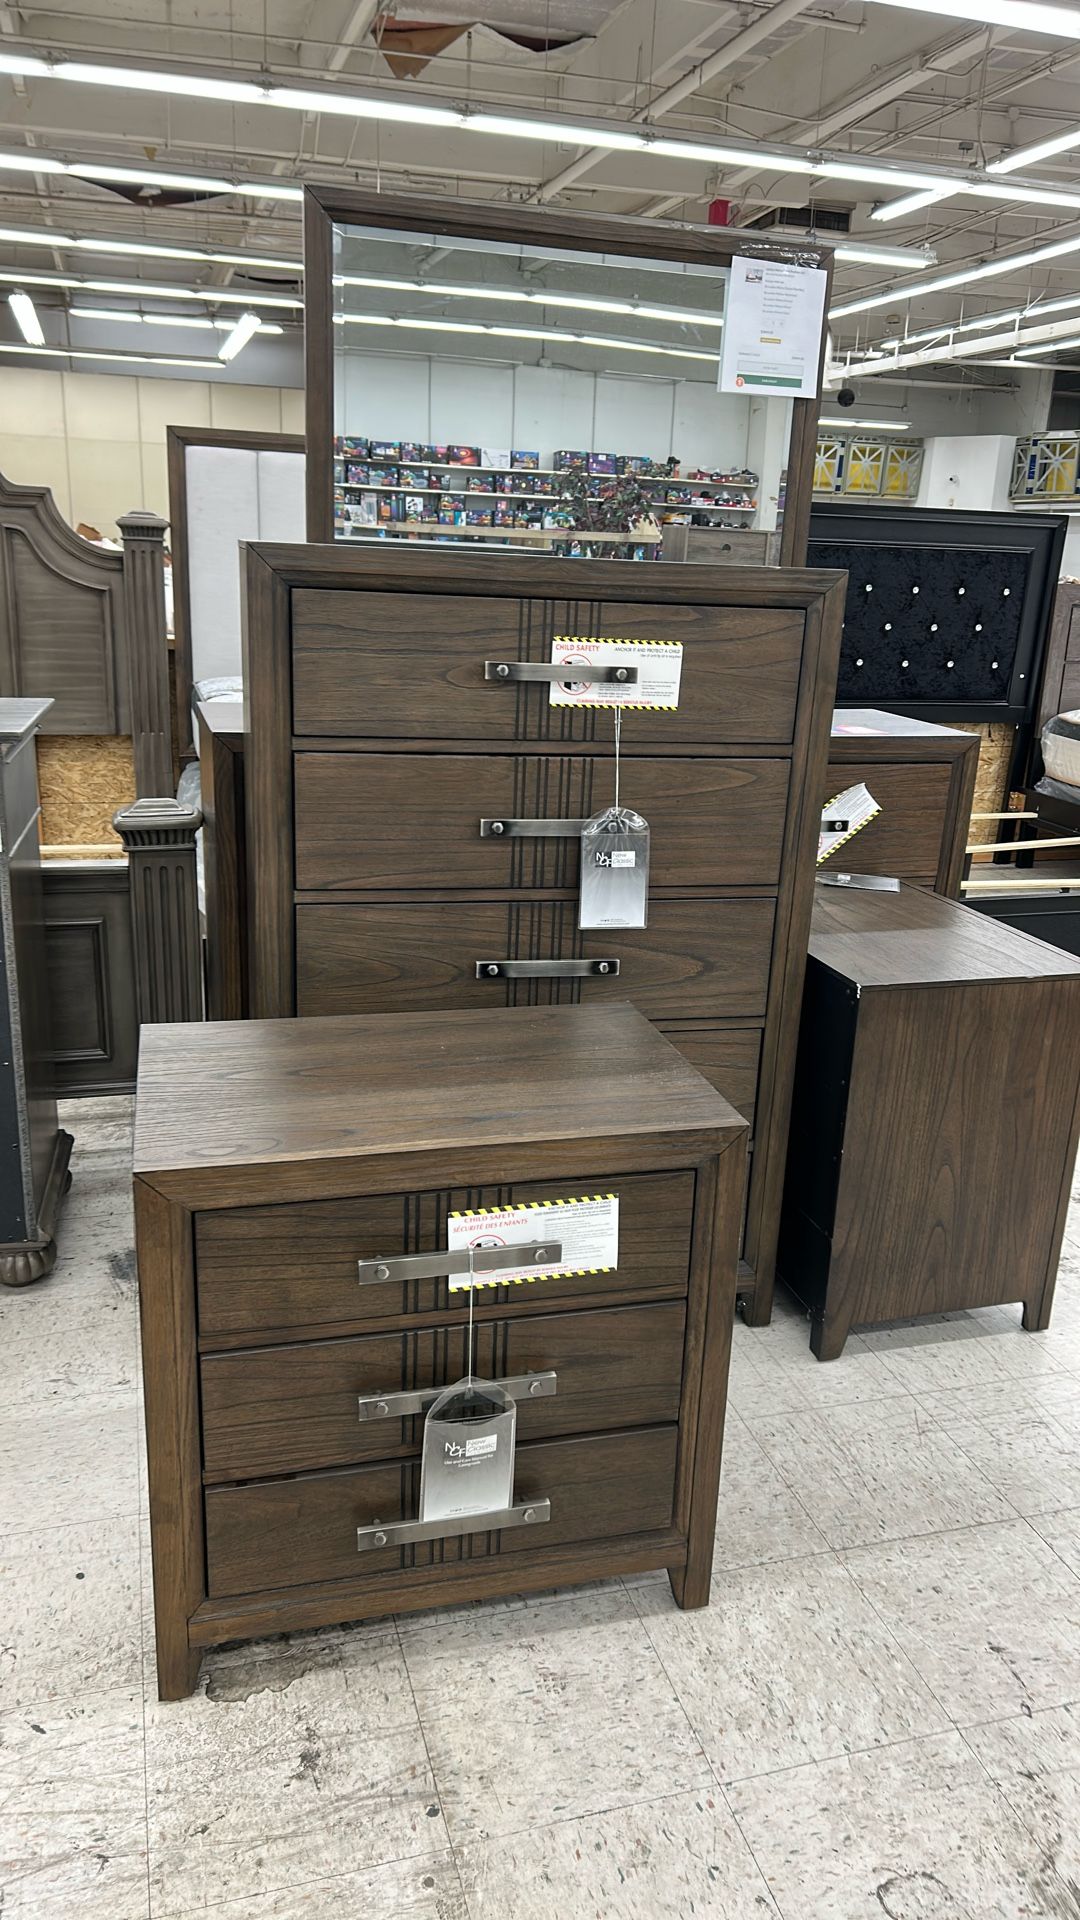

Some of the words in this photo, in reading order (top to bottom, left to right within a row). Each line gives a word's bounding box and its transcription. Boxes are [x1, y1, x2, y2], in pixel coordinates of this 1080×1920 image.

[490, 1212, 516, 1221] SAFETY
[453, 1223, 484, 1233] SÉCURITÉ
[499, 1218, 528, 1227] ENFANTS
[445, 1441, 466, 1457] NCF
